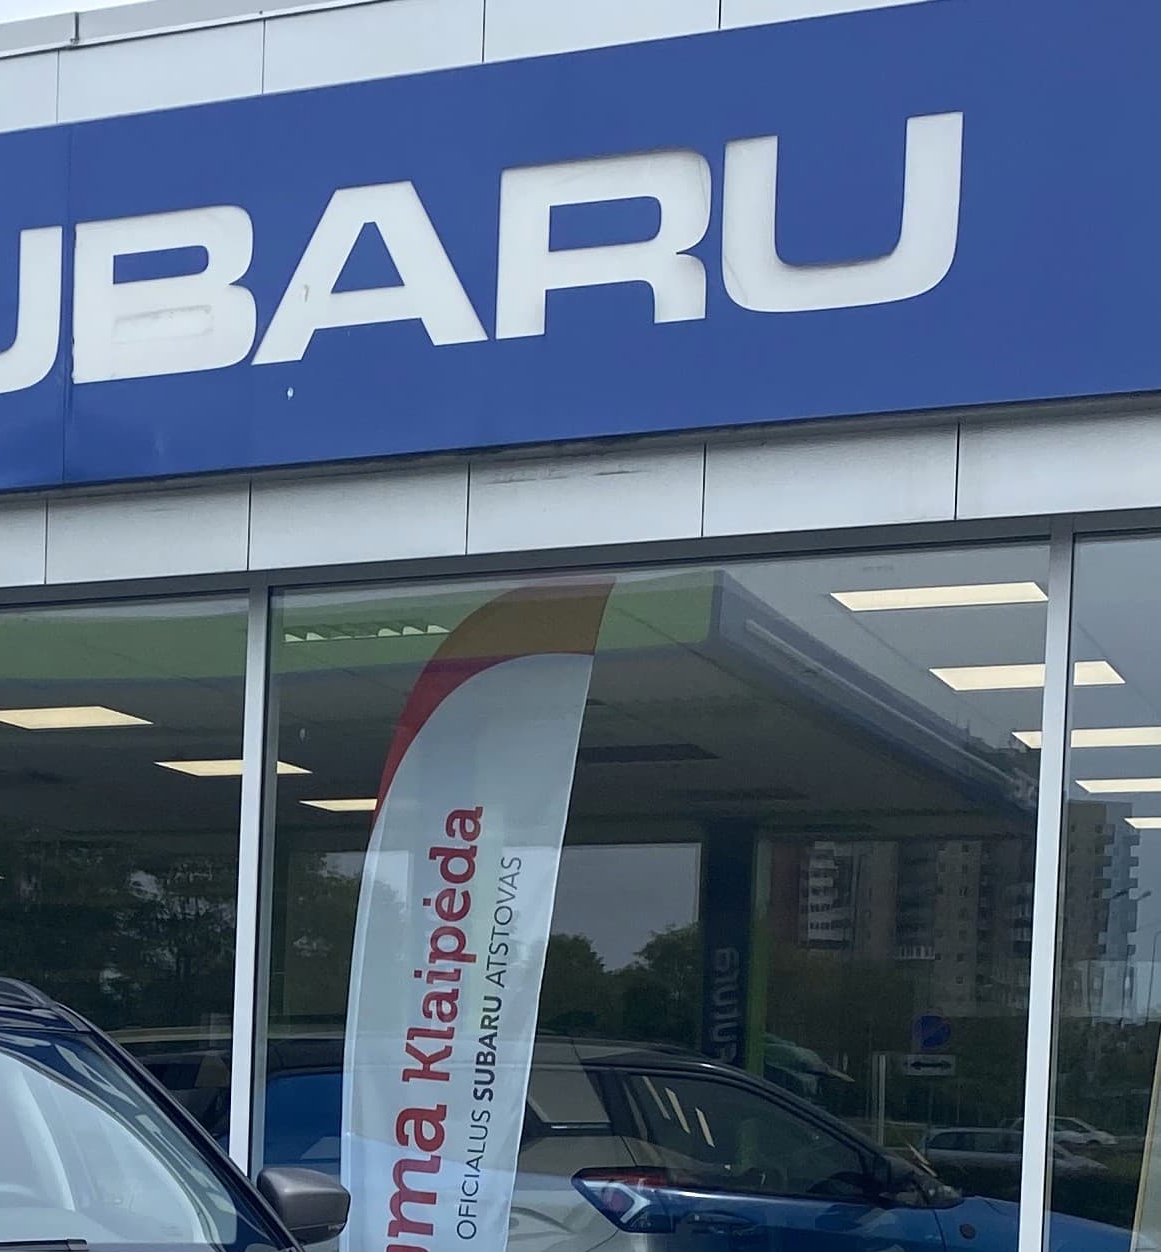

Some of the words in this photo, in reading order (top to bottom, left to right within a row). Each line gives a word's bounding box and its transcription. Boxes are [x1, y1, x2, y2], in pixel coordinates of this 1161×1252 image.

[401, 805, 484, 1083] Klaipėda
[485, 856, 523, 989] ATSTOVAS
[473, 995, 503, 1102] SUBARU
[456, 1110, 491, 1241] OFICIALUS
